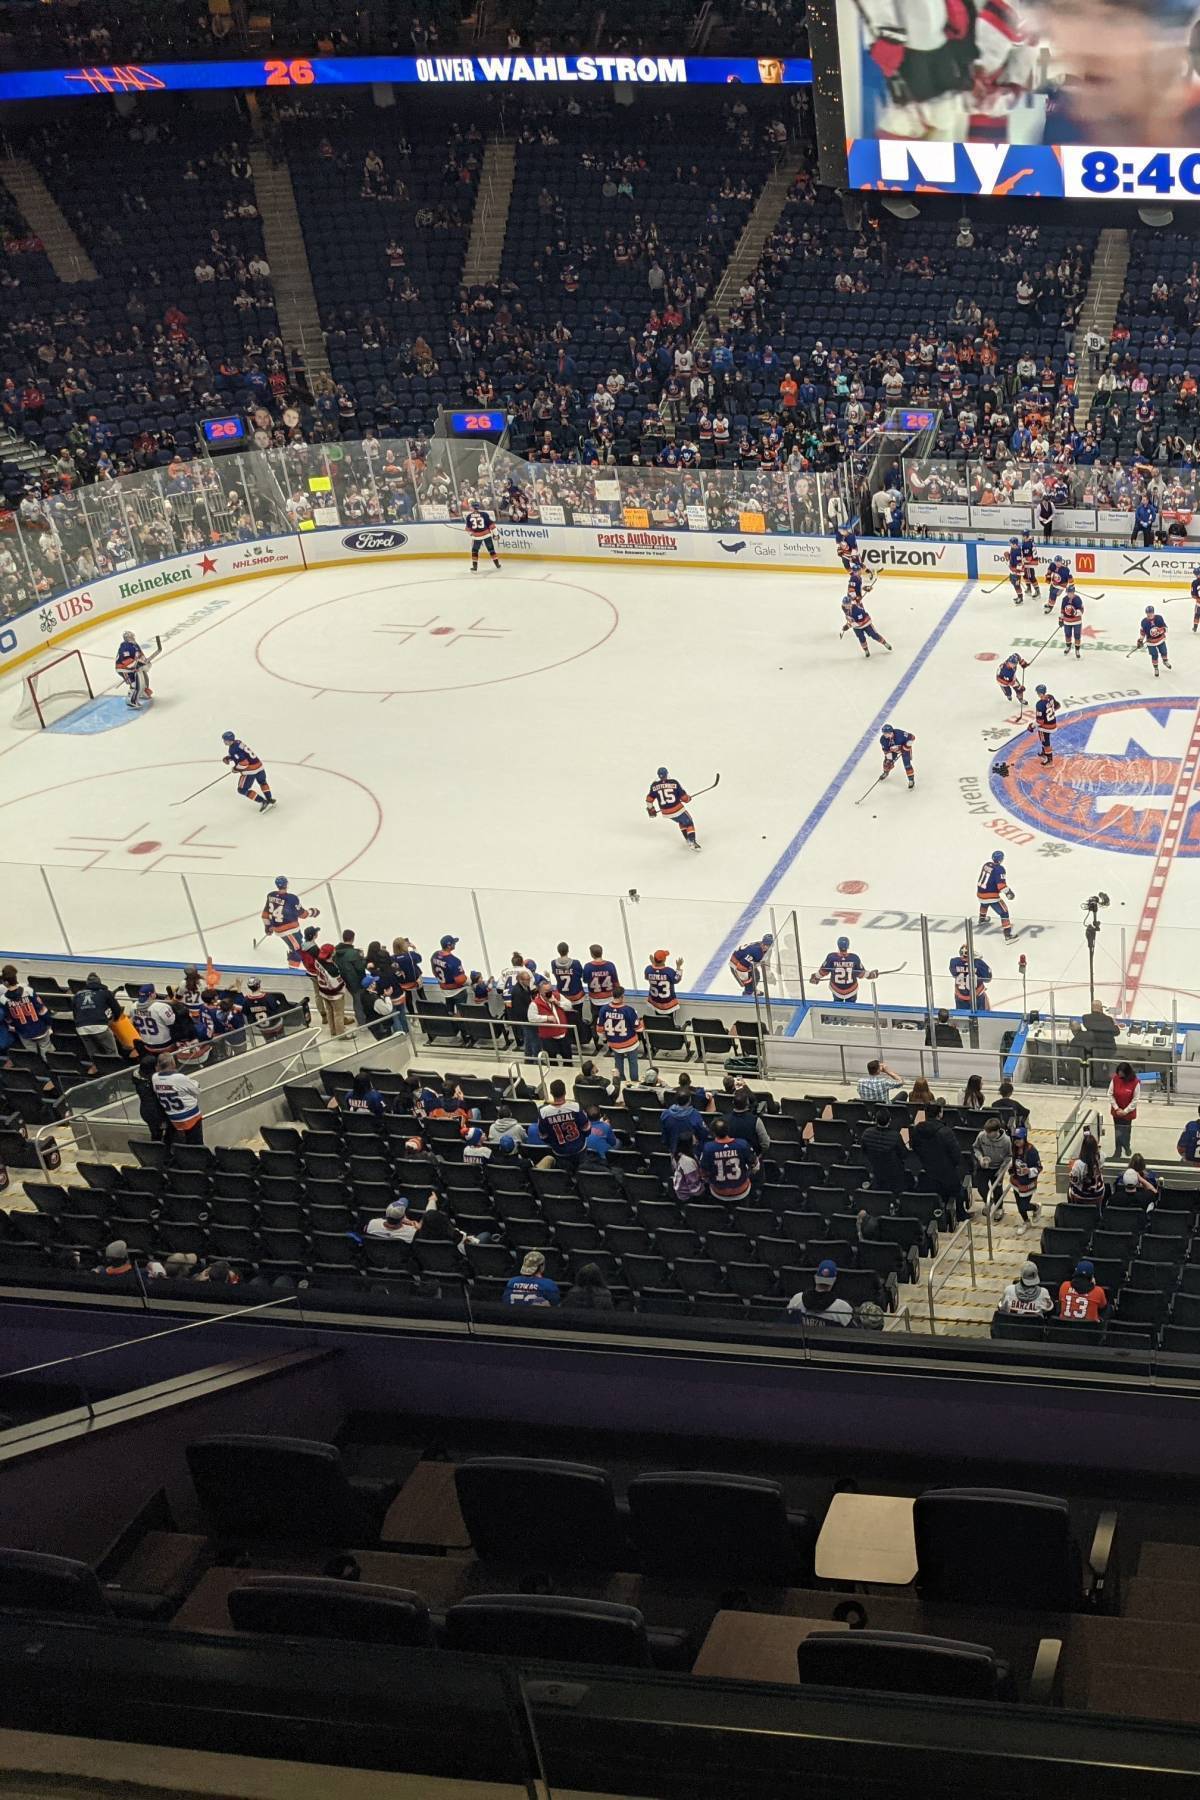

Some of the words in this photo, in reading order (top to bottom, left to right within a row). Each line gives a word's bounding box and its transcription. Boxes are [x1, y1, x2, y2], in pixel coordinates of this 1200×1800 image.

[265, 60, 315, 86] 26
[415, 59, 475, 82] OLIVER
[478, 57, 687, 82] WAHLSTROM
[210, 422, 238, 437] 26
[465, 415, 492, 430] 26
[905, 413, 930, 430] 26
[469, 516, 484, 529] 33
[355, 533, 395, 549] Ford
[496, 528, 549, 539] Northwell
[597, 533, 625, 545] Parts
[627, 532, 677, 547] Authority
[497, 540, 530, 550] Health
[754, 547, 777, 557] Gale
[783, 543, 822, 553] Sotheby's
[860, 545, 936, 566] verizon
[119, 567, 192, 598] Heineken
[55, 592, 94, 622] UBS
[1062, 688, 1141, 708] Arena
[657, 788, 676, 805] 15
[959, 776, 997, 816] Arena
[983, 818, 1036, 846] UBS
[559, 976, 571, 992] 7
[590, 977, 614, 991] 44
[834, 968, 854, 985] 21
[649, 980, 671, 998] 53
[9, 1002, 39, 1025] 44
[604, 1018, 628, 1036] 44
[548, 1112, 576, 1124] BARZAL
[553, 1121, 581, 1145] 13
[714, 1158, 742, 1181] 13
[1011, 1301, 1038, 1311] BARZAL
[1063, 1295, 1089, 1319] 13
